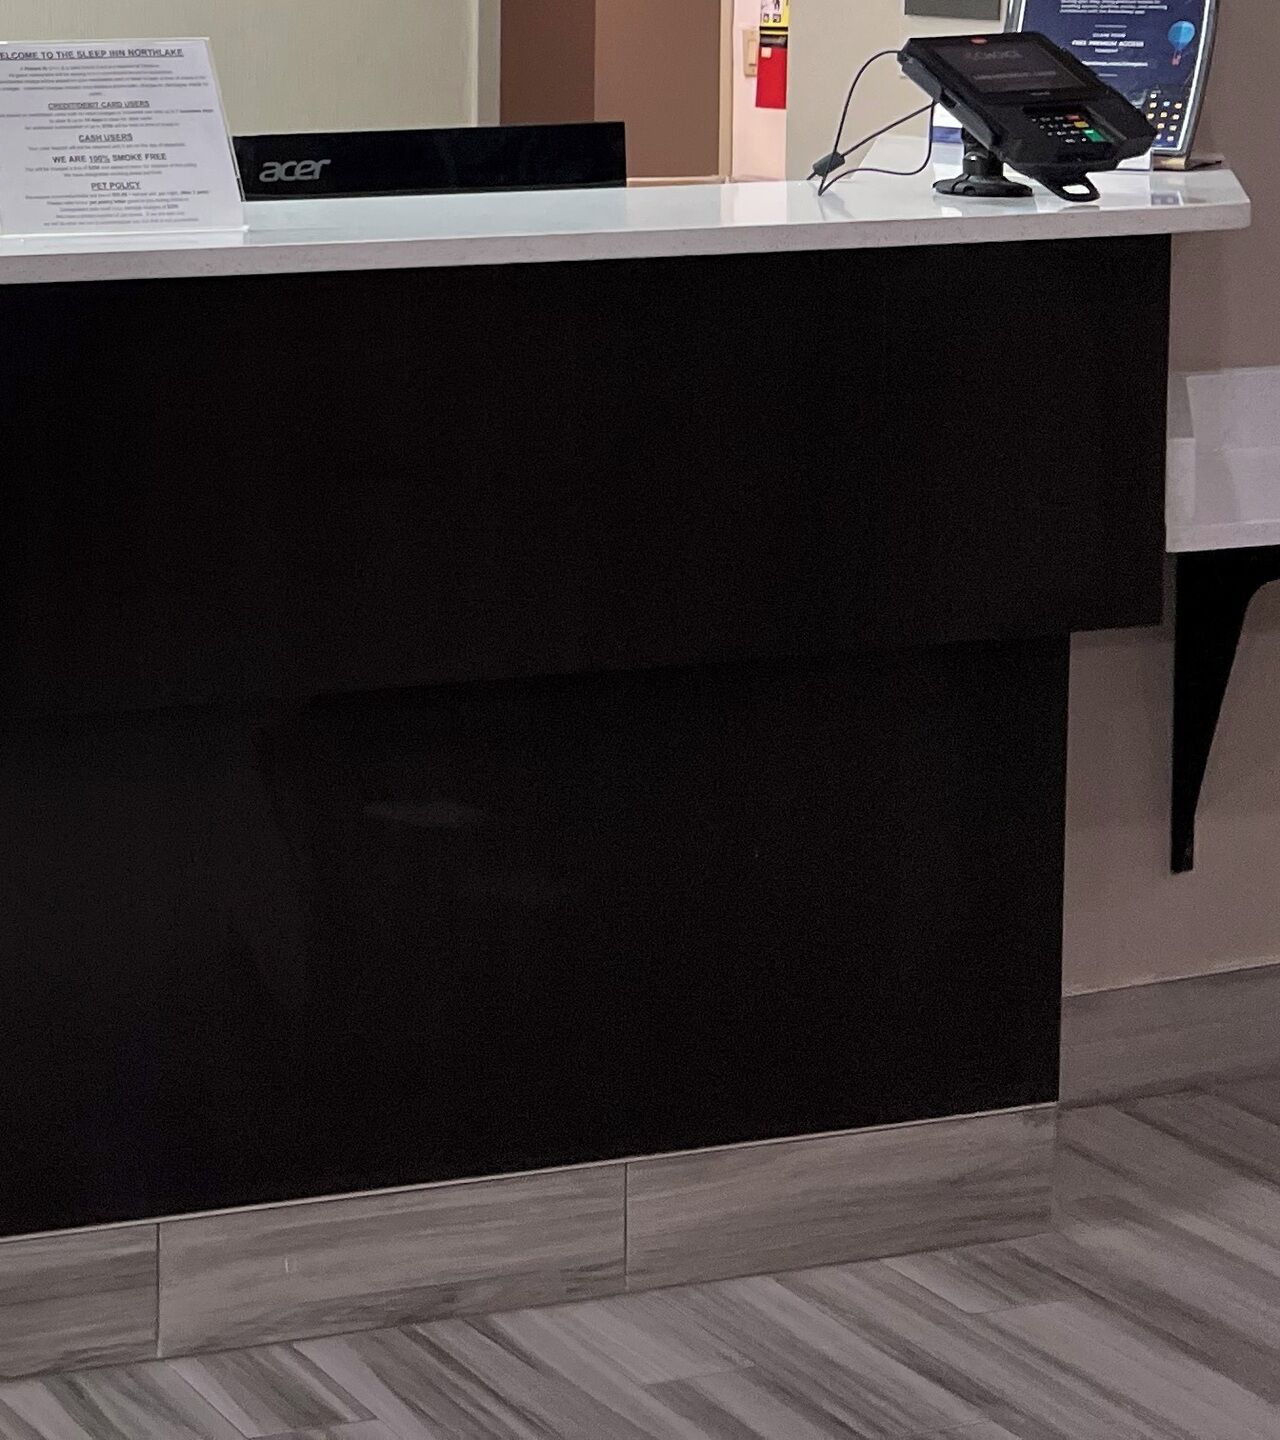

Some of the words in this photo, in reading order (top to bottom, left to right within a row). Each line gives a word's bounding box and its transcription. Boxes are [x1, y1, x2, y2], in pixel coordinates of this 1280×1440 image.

[41, 51, 54, 60] TO
[56, 50, 74, 59] THE
[76, 50, 107, 59] SLEEP
[109, 49, 126, 58] INN
[127, 48, 184, 58] NORTHLAKE
[101, 101, 123, 109] CARD
[124, 100, 150, 109] USERS
[78, 134, 102, 143] CASH
[104, 133, 133, 142] USERS
[52, 155, 67, 163] WE
[69, 155, 87, 163] ARE
[112, 153, 142, 162] SMOKE
[259, 159, 332, 182] acer
[90, 182, 107, 191] PET
[109, 181, 141, 191] POLICY
